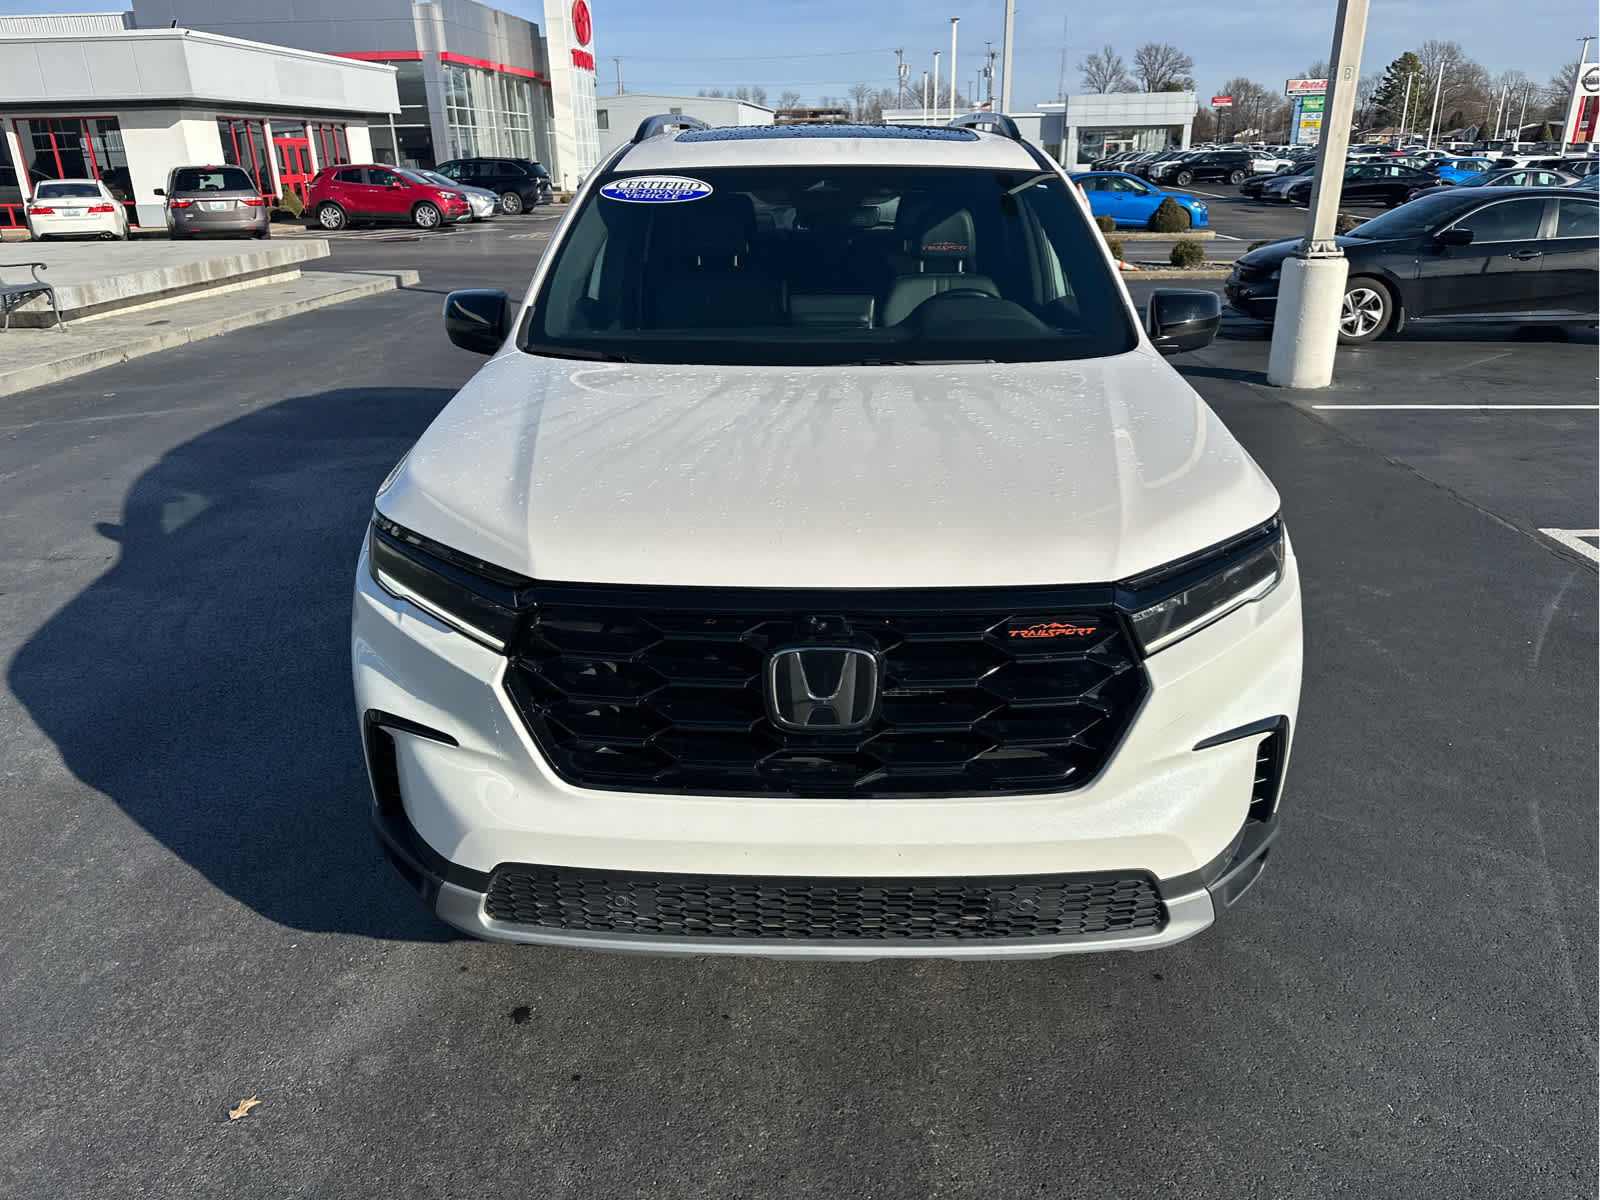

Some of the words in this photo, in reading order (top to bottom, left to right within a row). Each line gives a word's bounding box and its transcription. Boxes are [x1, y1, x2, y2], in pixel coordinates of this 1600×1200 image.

[1299, 80, 1328, 89] AutoZ
[615, 180, 702, 190] CERTIFIED
[615, 188, 694, 196] PRE-OWNED
[1008, 627, 1097, 638] TRAILSPORT
